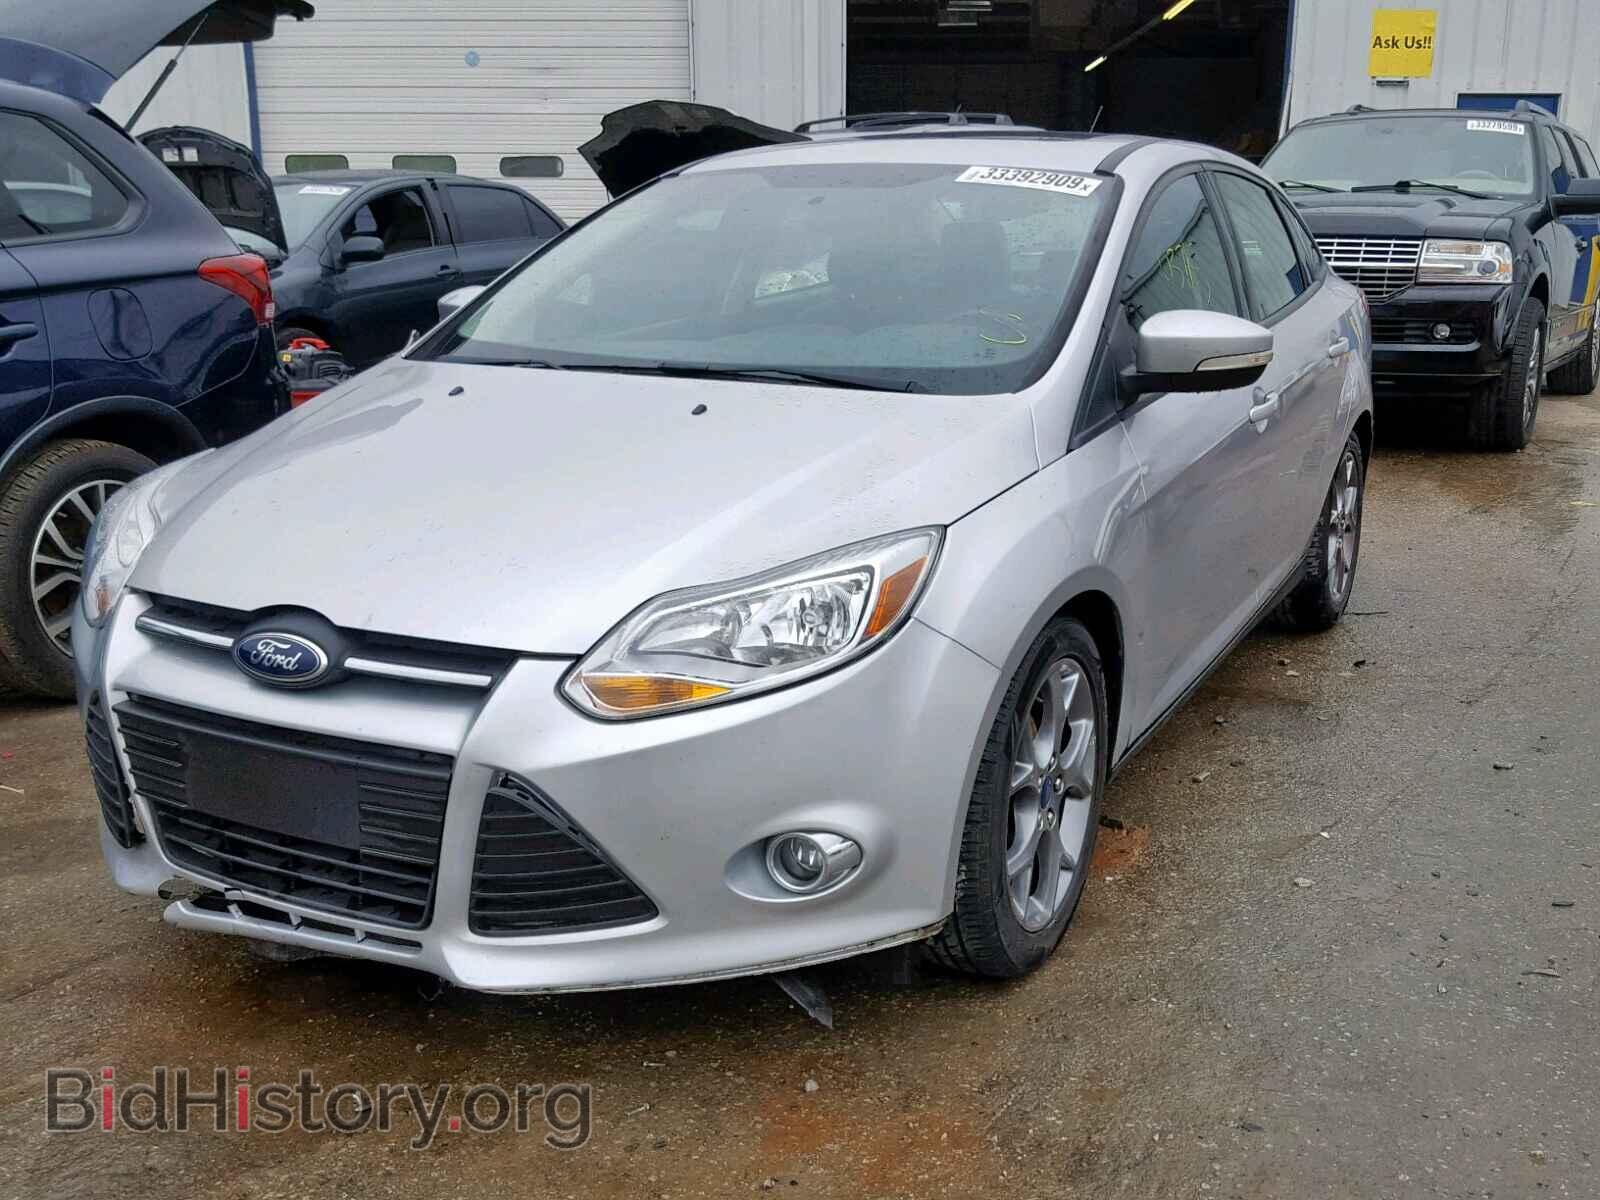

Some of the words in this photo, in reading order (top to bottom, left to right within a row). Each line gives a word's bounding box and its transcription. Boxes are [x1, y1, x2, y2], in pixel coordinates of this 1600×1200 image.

[1372, 35, 1400, 49] Ask
[1404, 35, 1432, 49] Us!!
[250, 639, 302, 671] Ford
